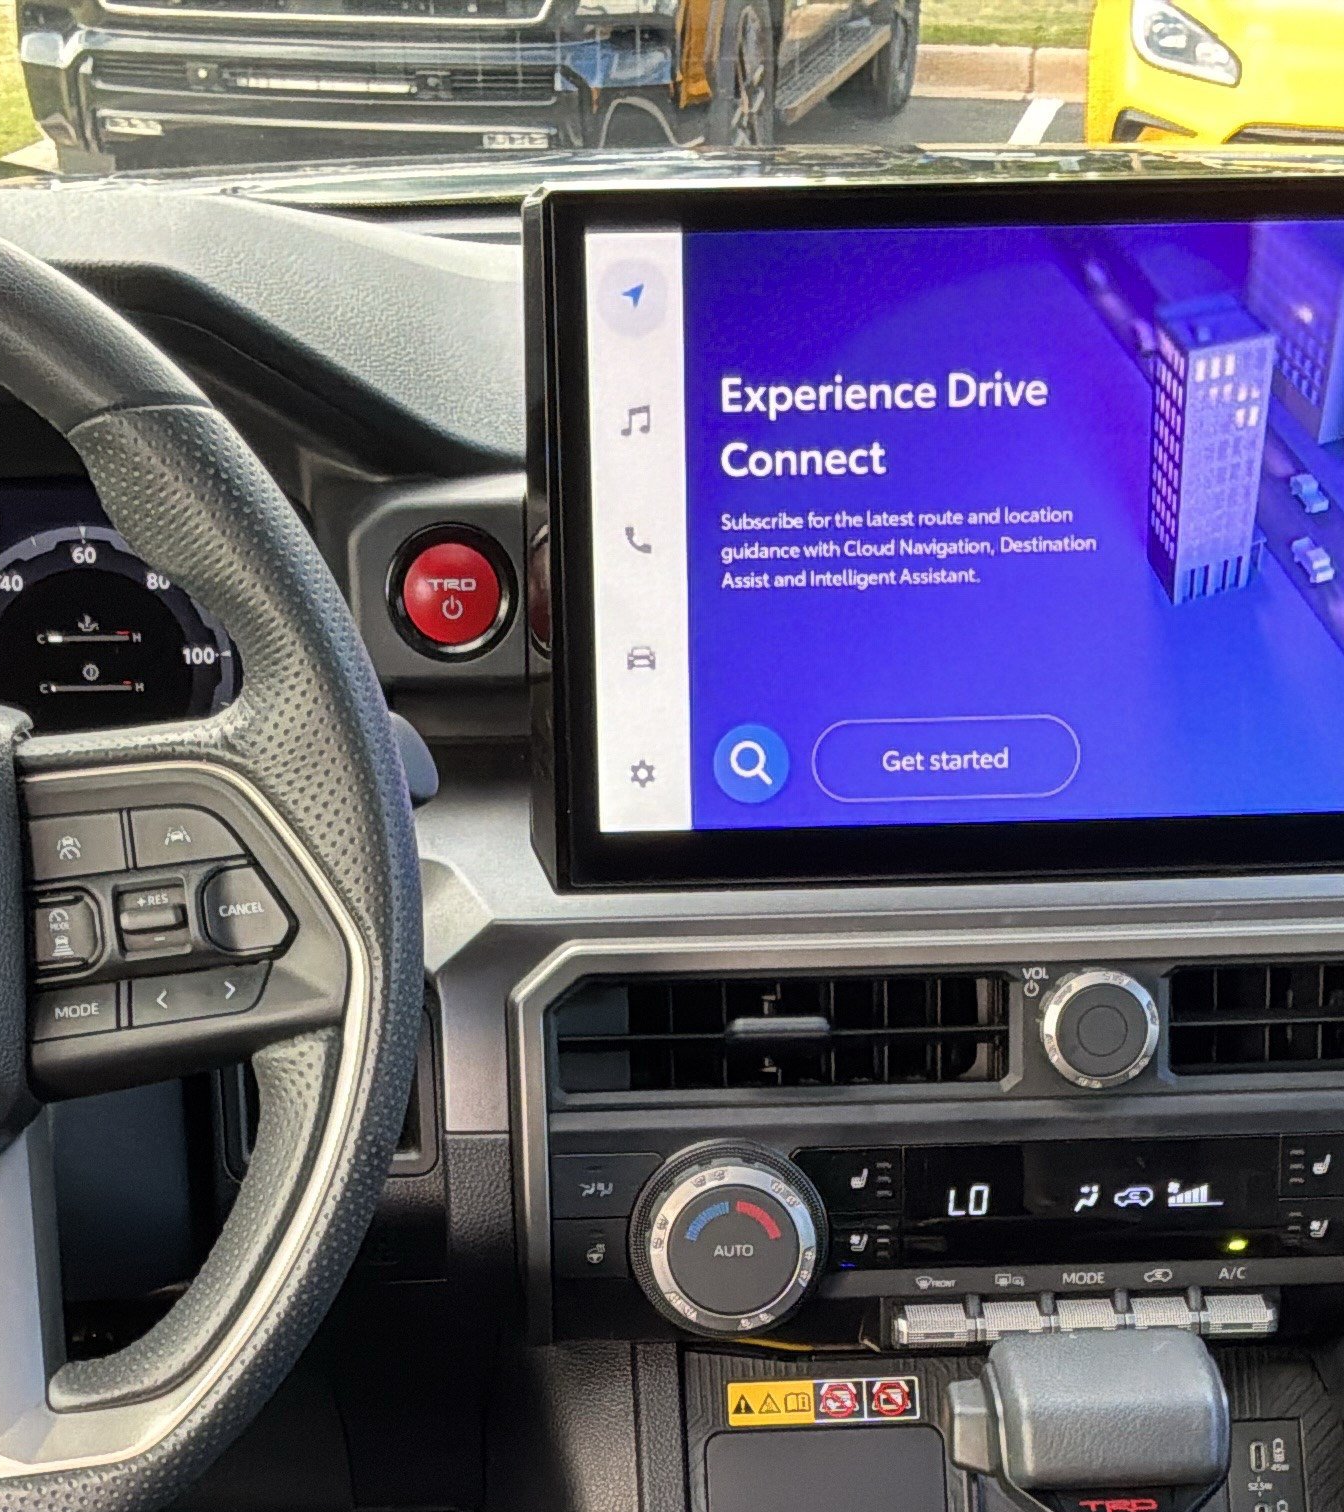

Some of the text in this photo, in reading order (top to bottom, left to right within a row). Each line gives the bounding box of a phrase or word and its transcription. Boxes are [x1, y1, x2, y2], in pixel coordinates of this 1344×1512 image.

[721, 370, 1048, 421] Experience Drive
[721, 441, 887, 477] Connect
[721, 506, 1073, 531] Subscribe for the latest route and location
[72, 546, 97, 565] 60
[721, 534, 1097, 564] guidance with Cloud Navigation, Destination
[147, 573, 171, 591] 80
[428, 578, 477, 592] TRD
[721, 566, 981, 591] Assist and Intelligent Assistant.
[183, 648, 216, 666] 100
[882, 747, 1009, 772] Get started
[218, 900, 265, 918] CANCEL
[1022, 967, 1049, 980] VOL
[54, 1002, 100, 1020] MODE
[947, 1184, 990, 1217] LO
[713, 1244, 754, 1257] AUTO
[1062, 1271, 1106, 1285] MODE
[1218, 1265, 1247, 1280] A/C
[931, 1279, 957, 1288] FRONT
